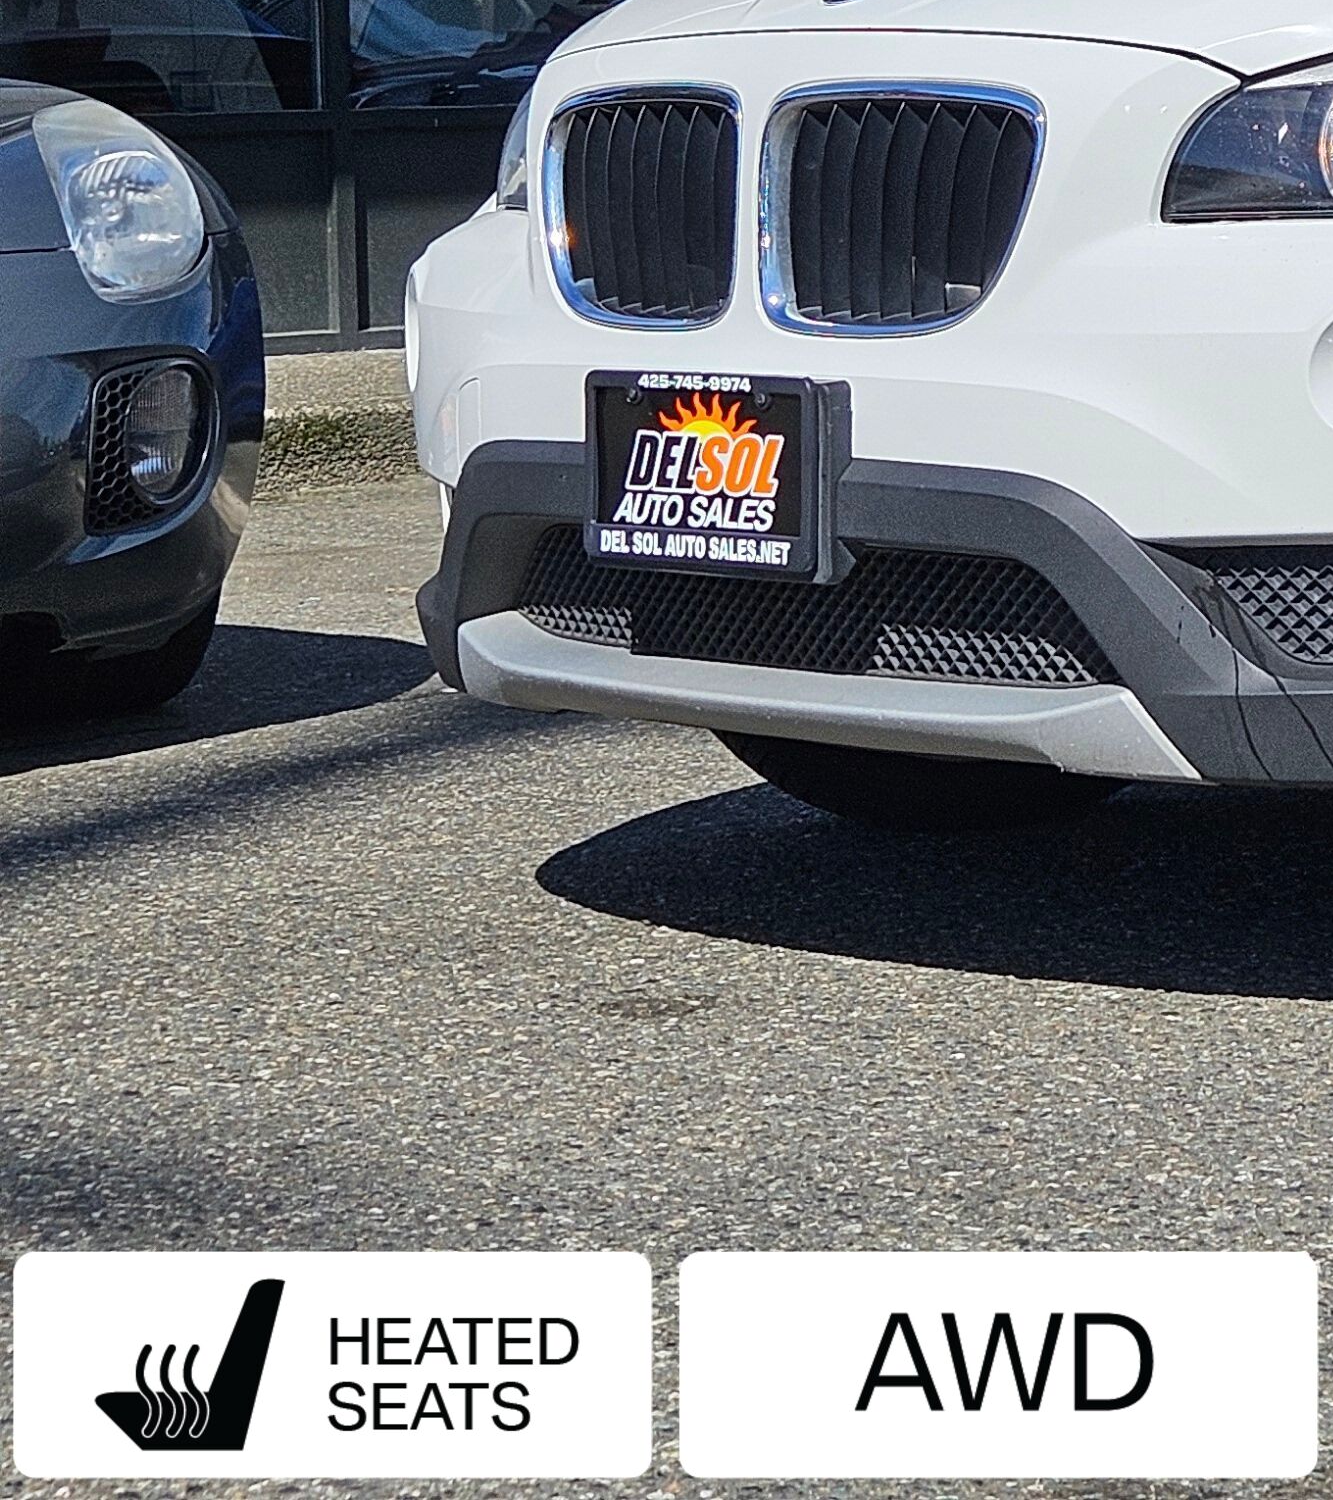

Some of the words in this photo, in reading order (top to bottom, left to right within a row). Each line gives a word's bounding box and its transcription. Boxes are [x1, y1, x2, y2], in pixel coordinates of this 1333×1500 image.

[638, 374, 751, 393] 425-745-9974
[613, 492, 685, 527] AUTO
[687, 497, 776, 532] SALES
[600, 529, 630, 554] DEL
[632, 530, 662, 556] SOL
[665, 533, 707, 559] AUTO
[709, 536, 791, 565] SALES.NET
